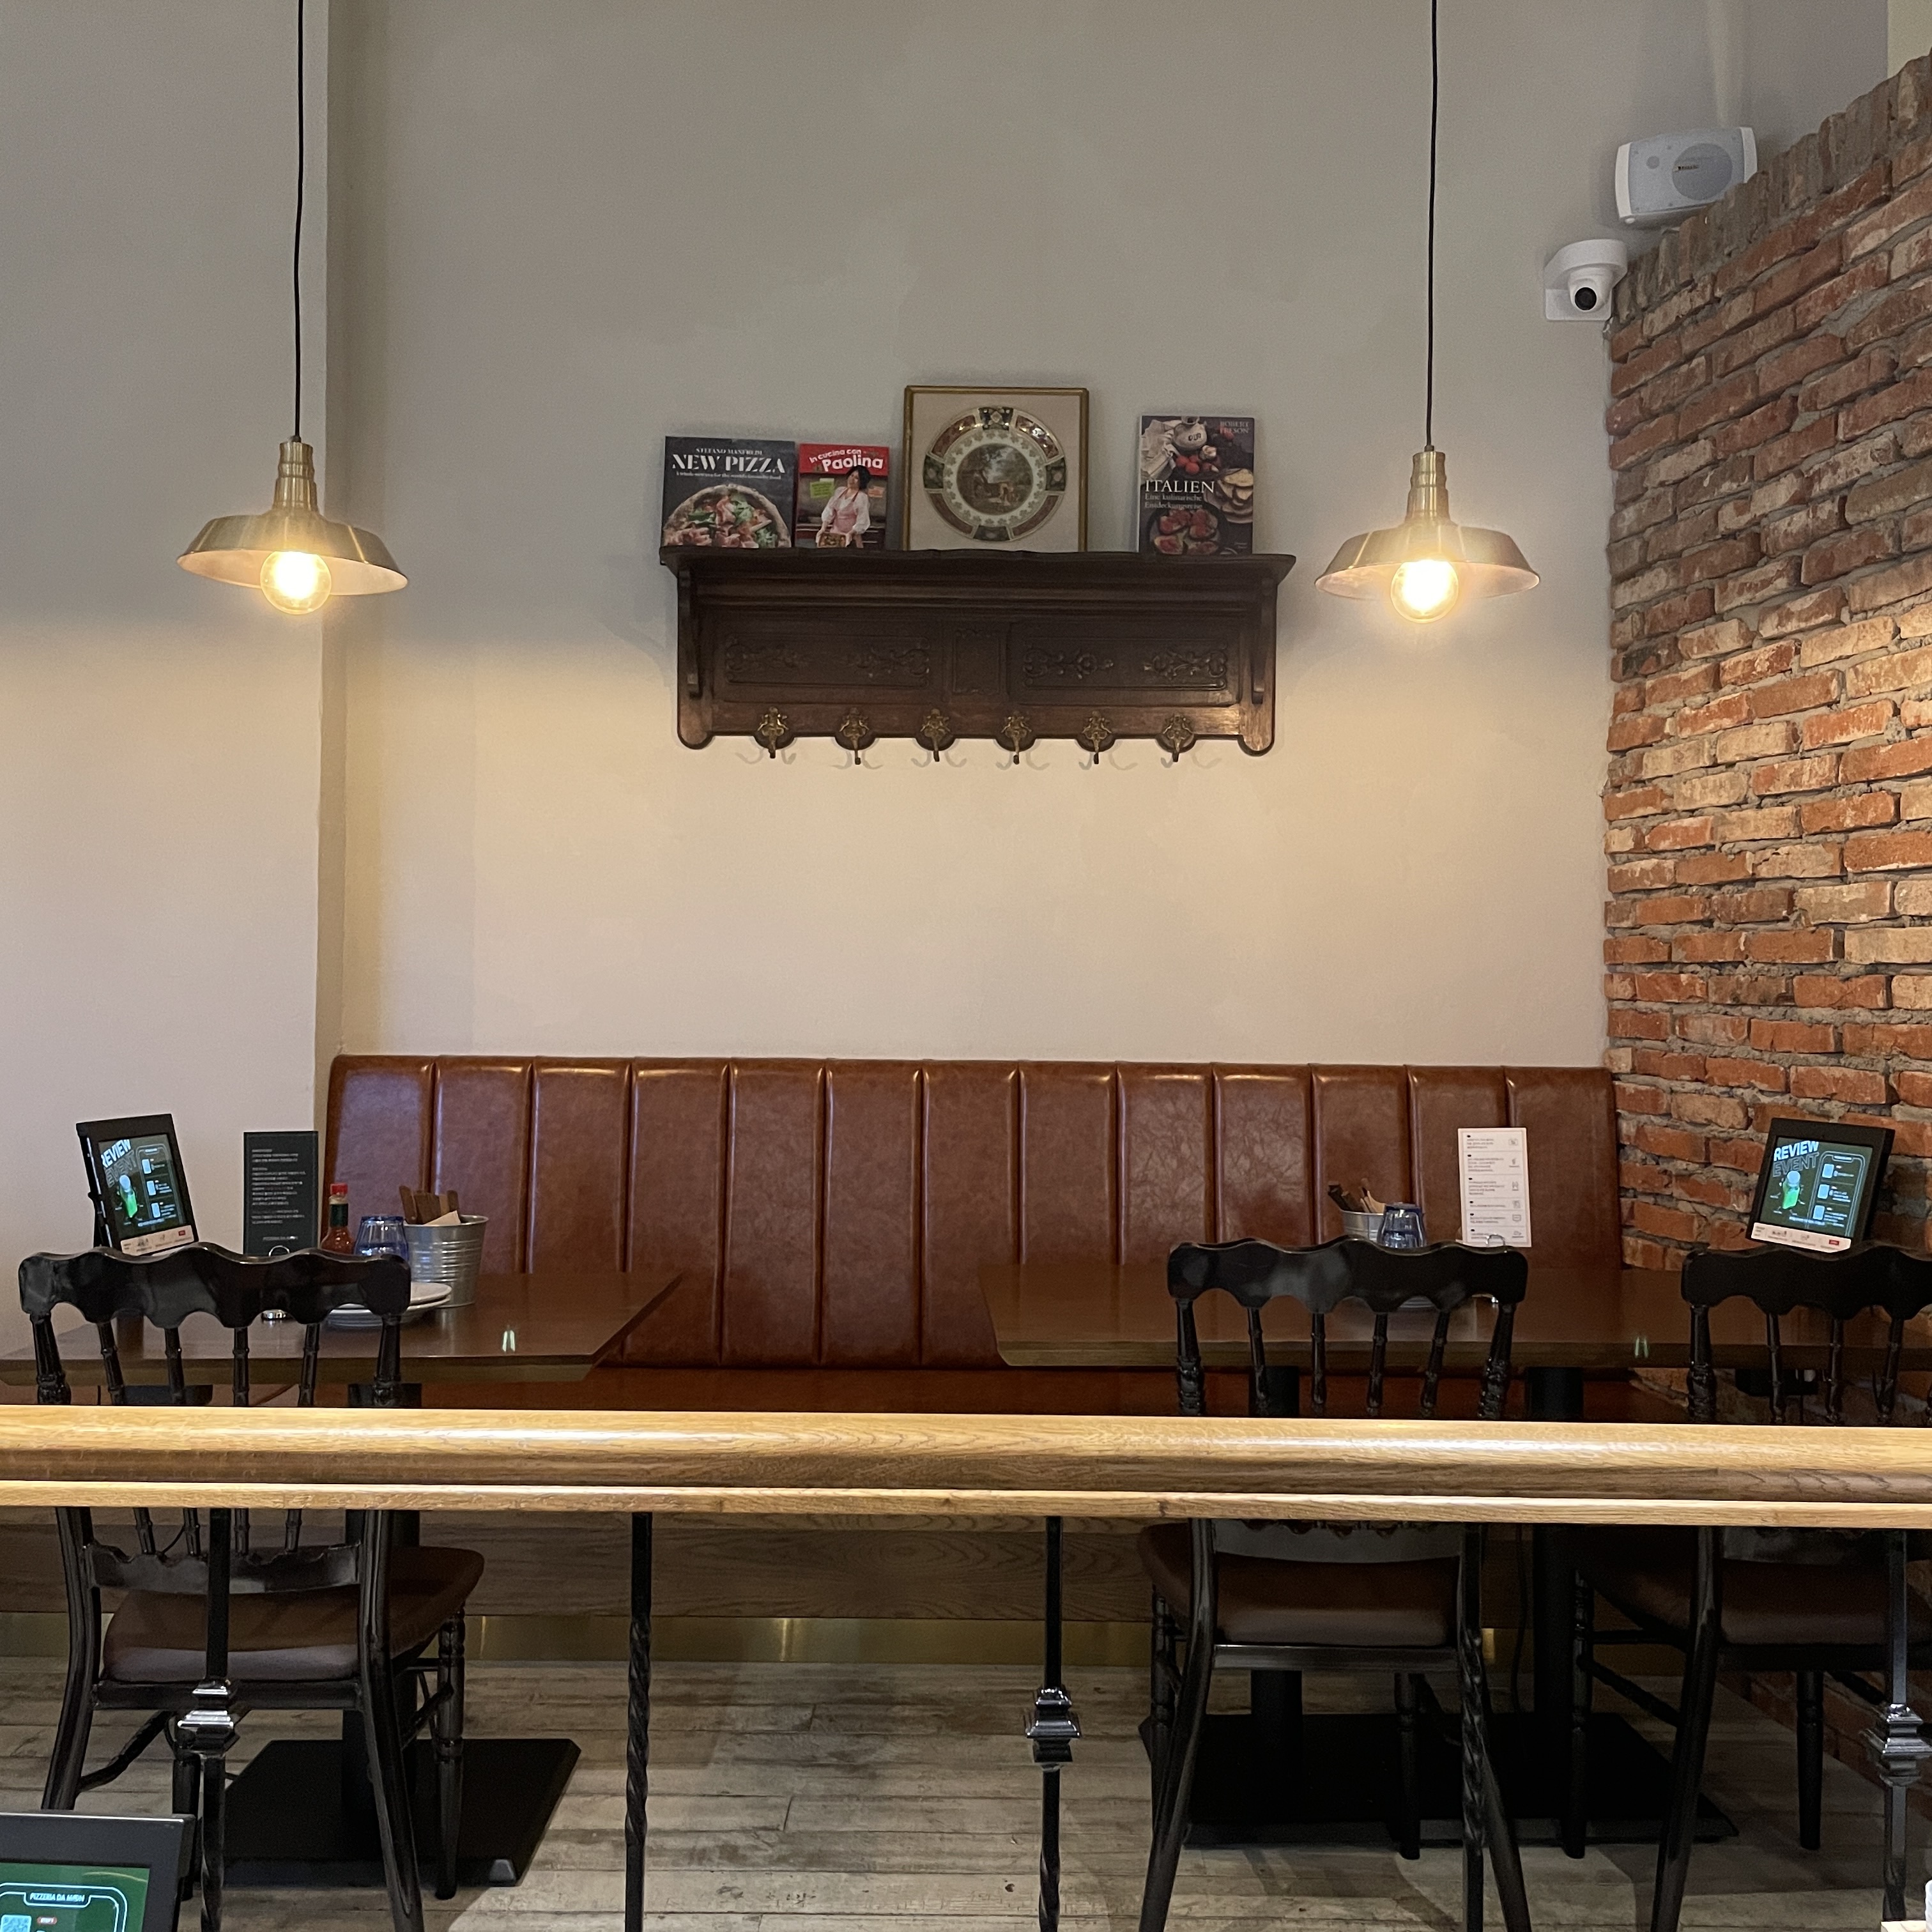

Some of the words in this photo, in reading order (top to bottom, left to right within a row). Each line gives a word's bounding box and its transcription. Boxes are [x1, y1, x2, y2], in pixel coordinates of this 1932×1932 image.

[672, 454, 720, 470] NEW
[725, 456, 785, 473] PIZZA
[818, 450, 845, 460] cucina
[822, 454, 884, 472] Paolina
[1145, 479, 1215, 493] ITALIEN
[1774, 1140, 1819, 1162] REVIEW
[103, 1150, 137, 1188] EVENT
[1773, 1152, 1820, 1177] EVENT
